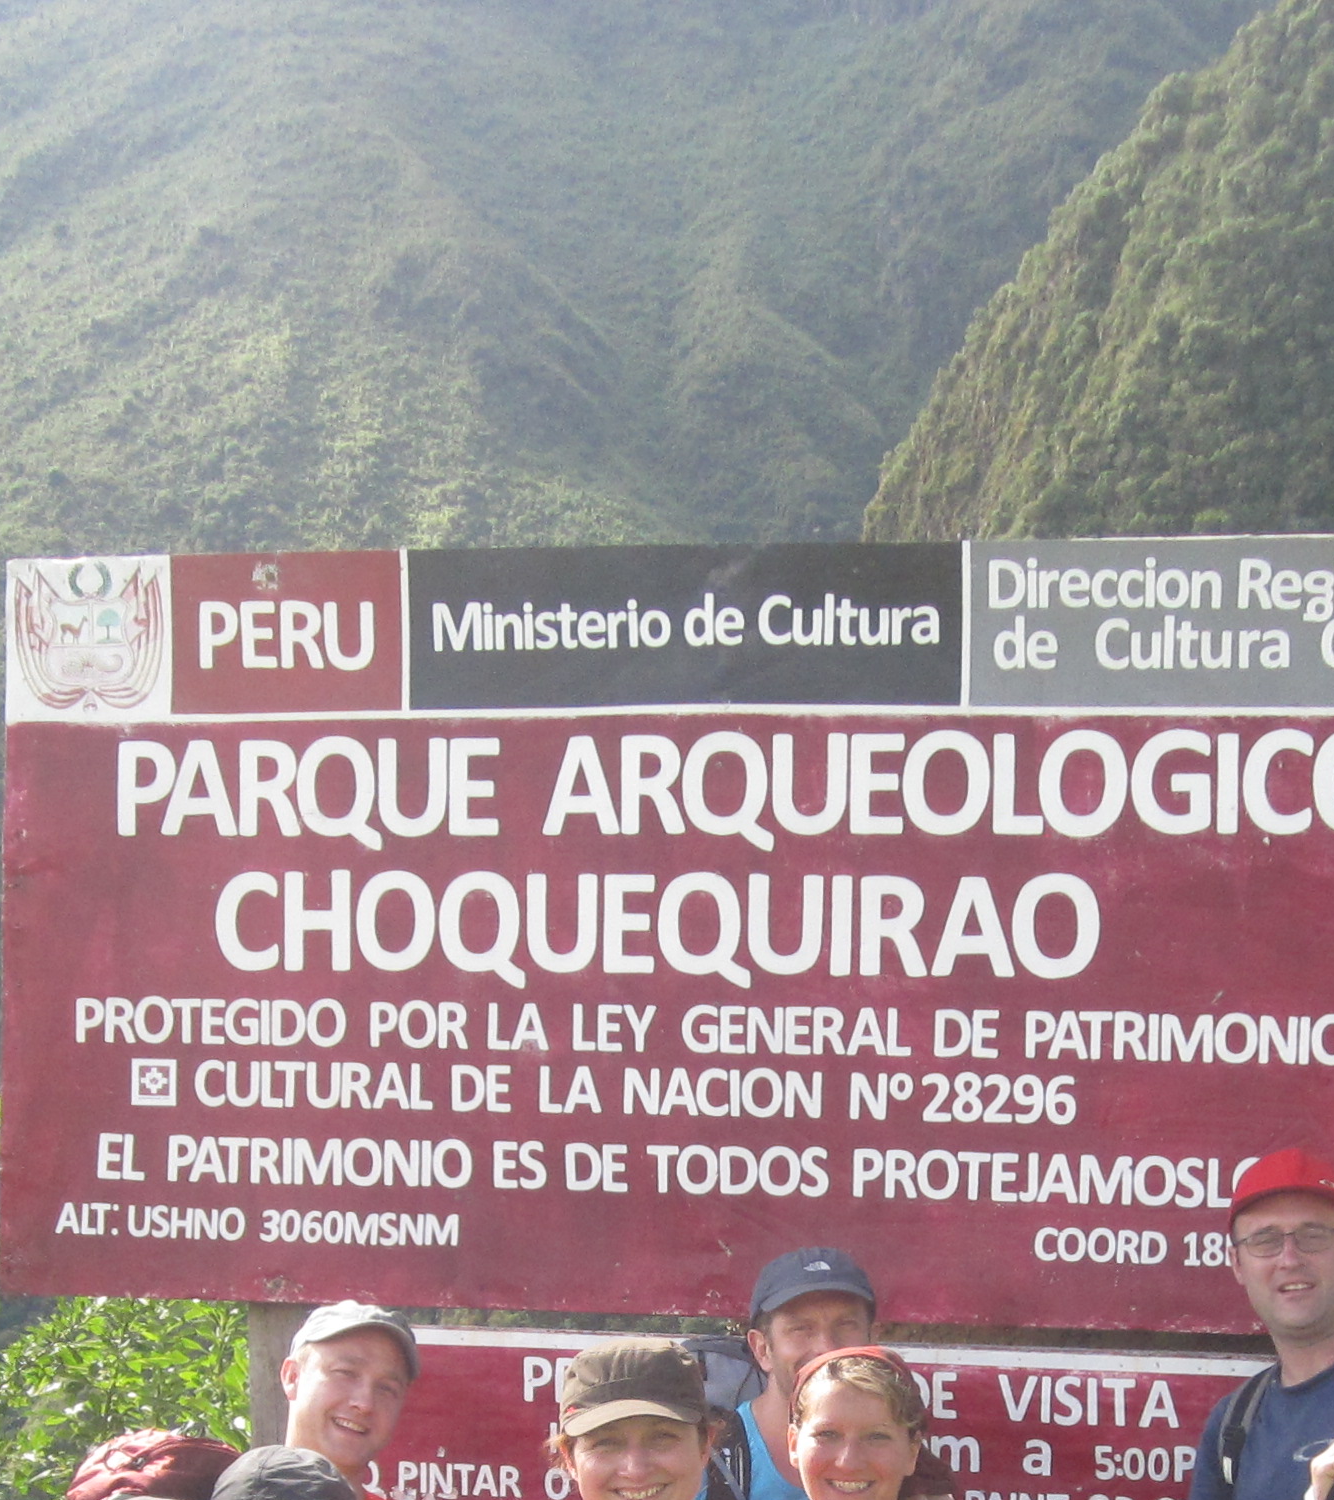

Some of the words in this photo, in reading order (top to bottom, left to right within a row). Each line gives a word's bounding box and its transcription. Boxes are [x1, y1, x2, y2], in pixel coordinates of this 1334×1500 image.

[988, 557, 1222, 609] Direccion
[199, 600, 375, 671] PERU
[432, 598, 671, 652] Ministerio
[683, 594, 745, 645] de
[757, 594, 940, 646] Cultura
[993, 618, 1058, 671] de
[1095, 615, 1291, 670] Cultura
[117, 736, 500, 851] PARQUE
[215, 869, 1101, 989] CHOQUEQUIRAO
[75, 997, 347, 1048] PROTEGIDO
[369, 1000, 468, 1051] POR
[487, 1002, 549, 1051] LA
[572, 1004, 657, 1054] LEY
[682, 1005, 911, 1057] GENERAL
[933, 1009, 1000, 1060] DE
[194, 1060, 434, 1112] CULTURAL
[451, 1063, 512, 1113] DE
[539, 1066, 602, 1114] LA
[623, 1067, 822, 1119] NACION
[96, 1132, 145, 1181] EL
[166, 1135, 472, 1189] PATRIMONIO
[493, 1140, 548, 1191] ES
[567, 1142, 629, 1193] DE
[647, 1145, 829, 1198] TODOS
[852, 1147, 1261, 1209] PROTEJAMOSL
[55, 1201, 120, 1236] ALT:
[128, 1202, 245, 1243] USHNO
[259, 1207, 460, 1248] 3060MSNM
[1034, 1226, 1167, 1267] COORD
[998, 1374, 1180, 1429] VISITA
[398, 1461, 522, 1499] PINTAR
[1022, 1438, 1053, 1476] a
